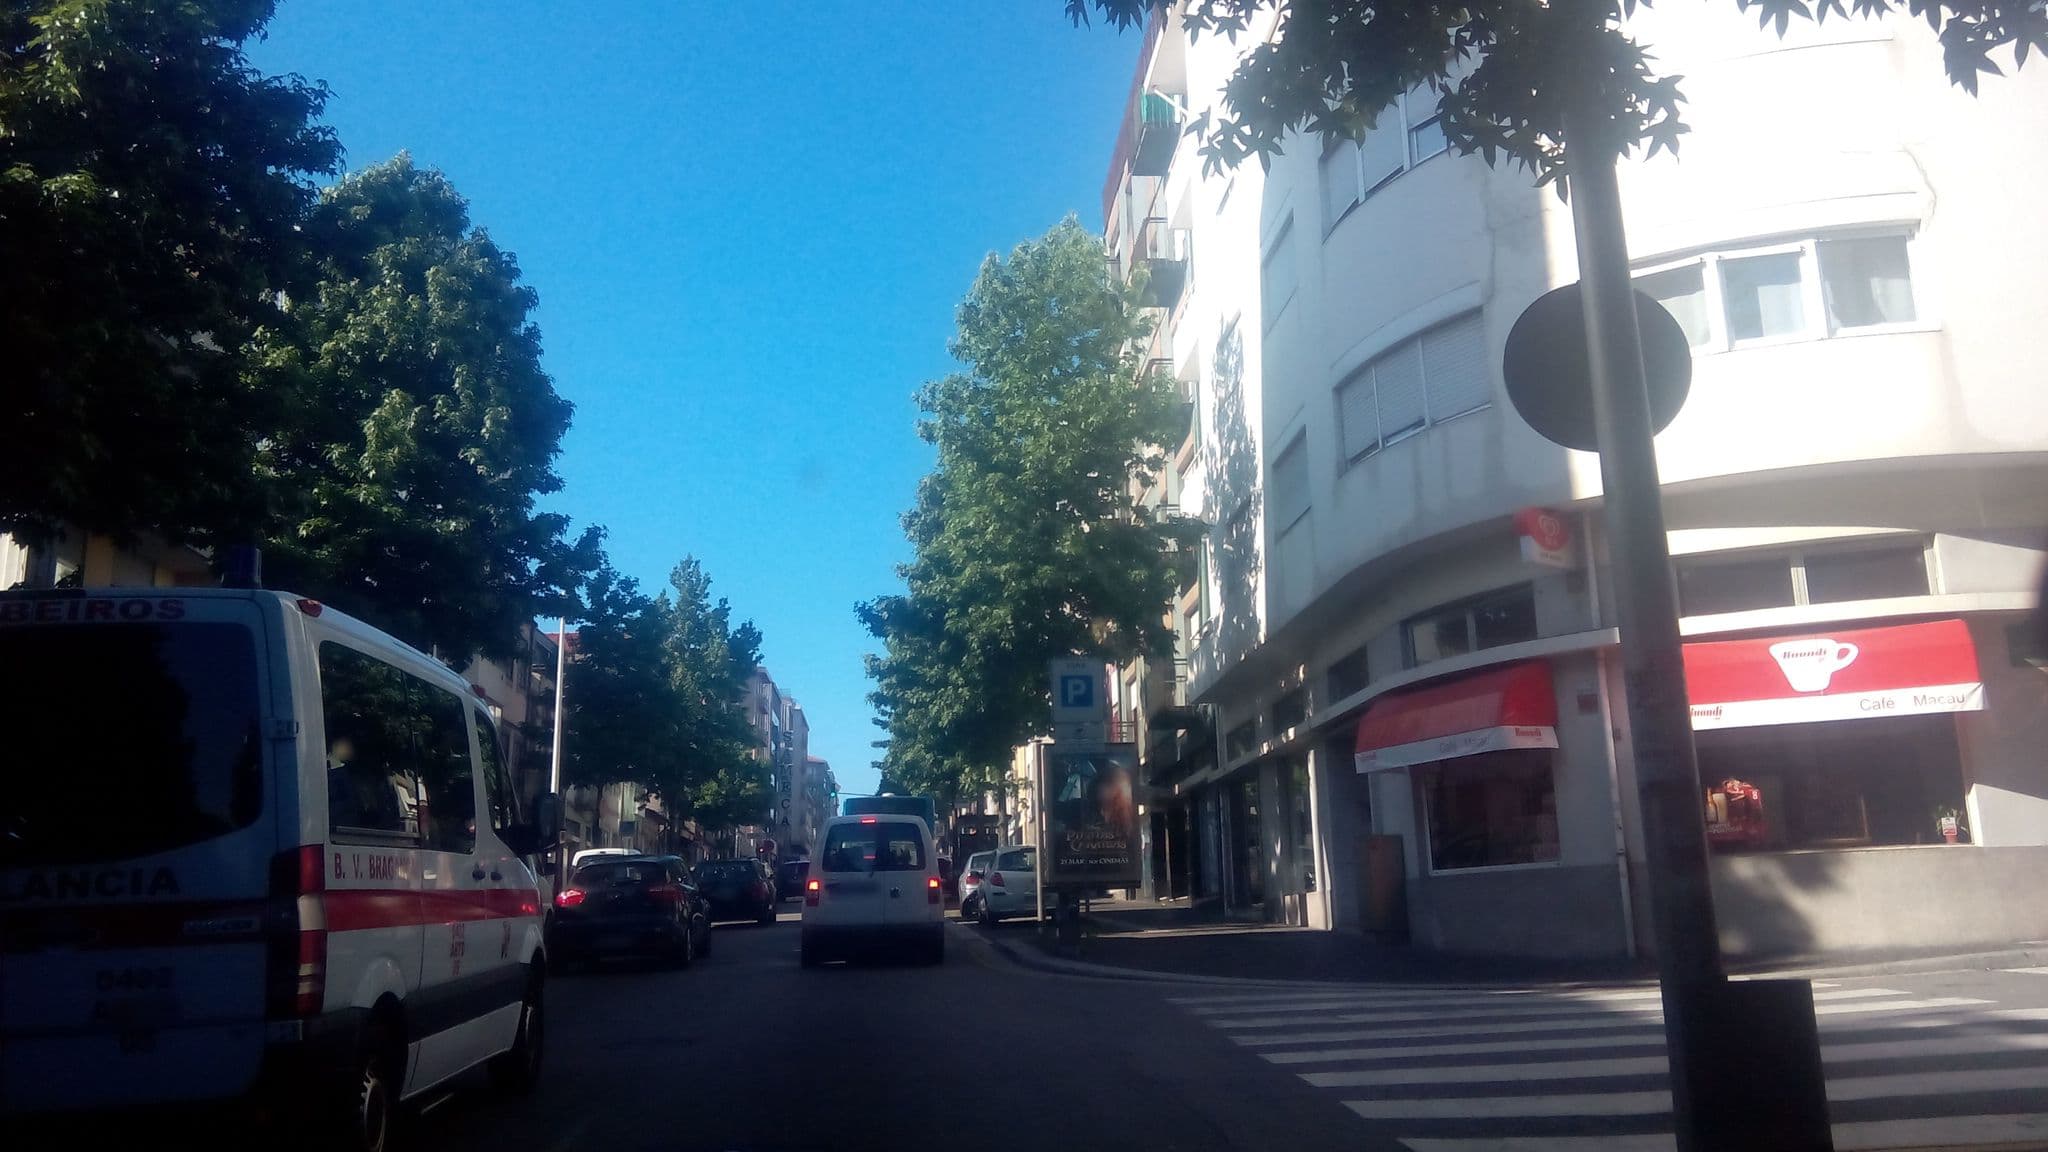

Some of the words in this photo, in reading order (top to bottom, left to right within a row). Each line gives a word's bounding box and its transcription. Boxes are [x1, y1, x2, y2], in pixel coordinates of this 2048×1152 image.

[1069, 679, 1087, 704] P
[1860, 696, 1896, 711] Café
[1913, 694, 1966, 707] Macau
